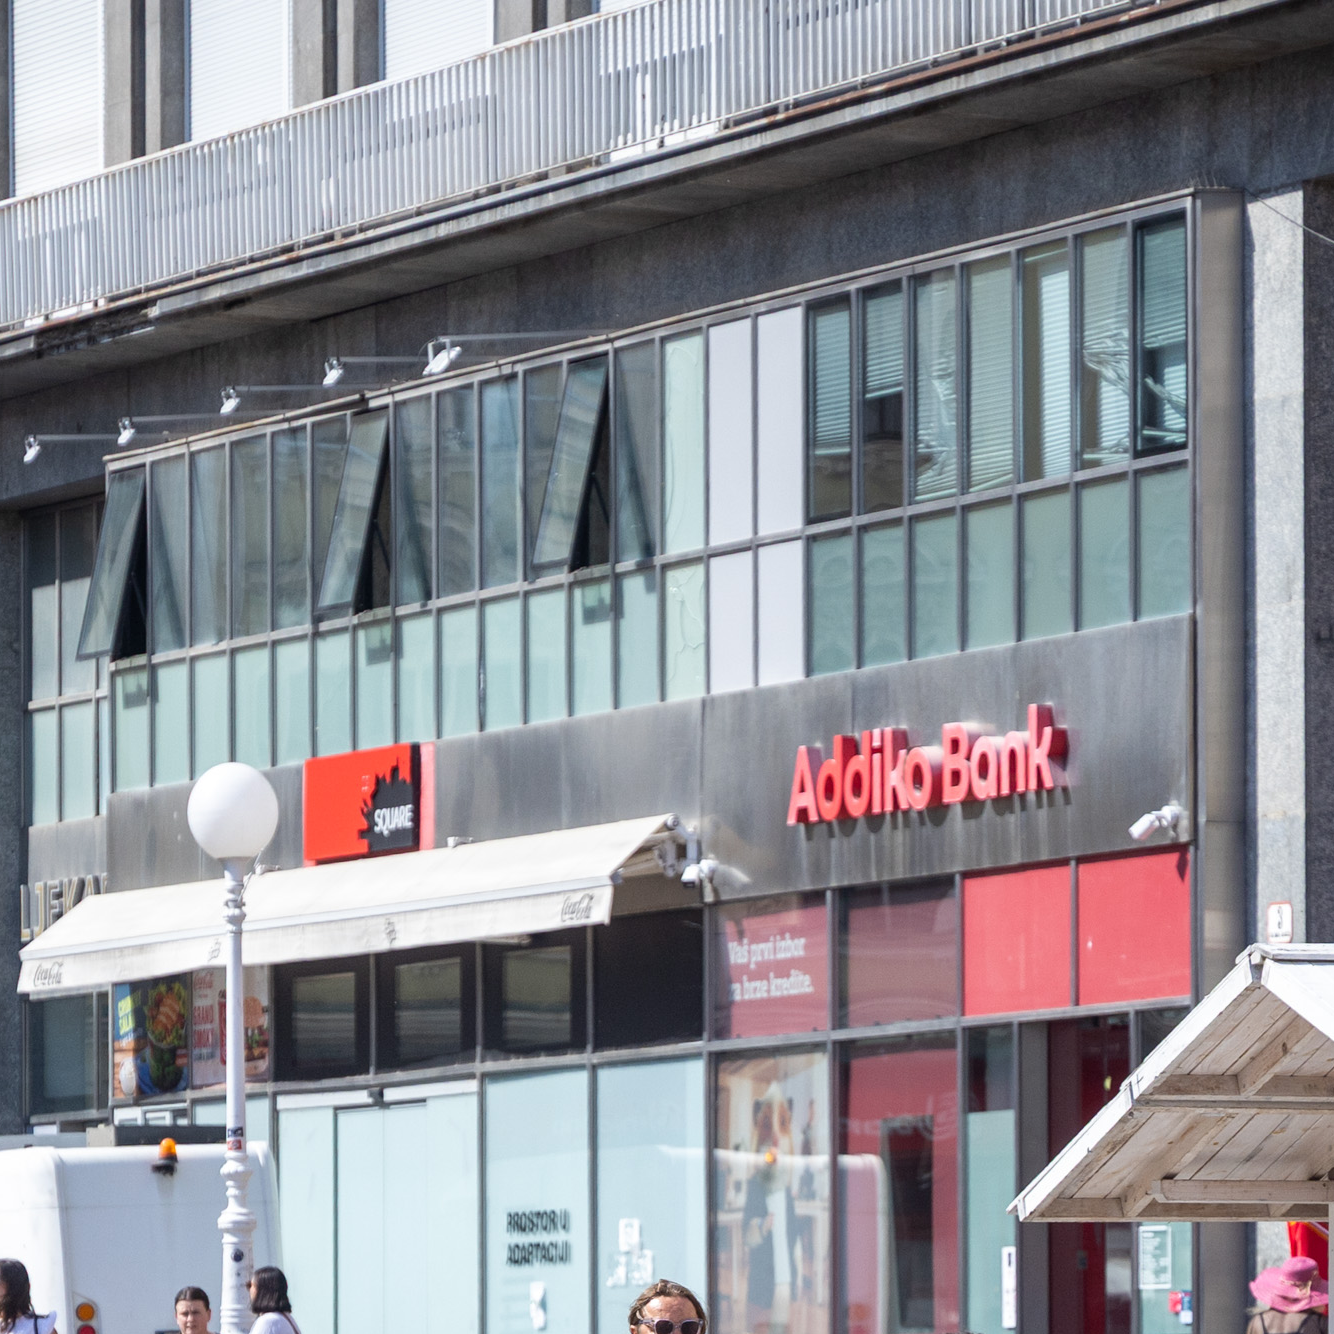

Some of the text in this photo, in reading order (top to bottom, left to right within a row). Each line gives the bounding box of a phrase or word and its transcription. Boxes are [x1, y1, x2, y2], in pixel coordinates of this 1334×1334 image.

[787, 703, 1059, 826] Addiko Bank
[374, 804, 414, 836] SQUARE
[728, 932, 806, 969] Vaš prvi izbor
[743, 975, 769, 1000] brze
[506, 1209, 559, 1235] PROSTOR
